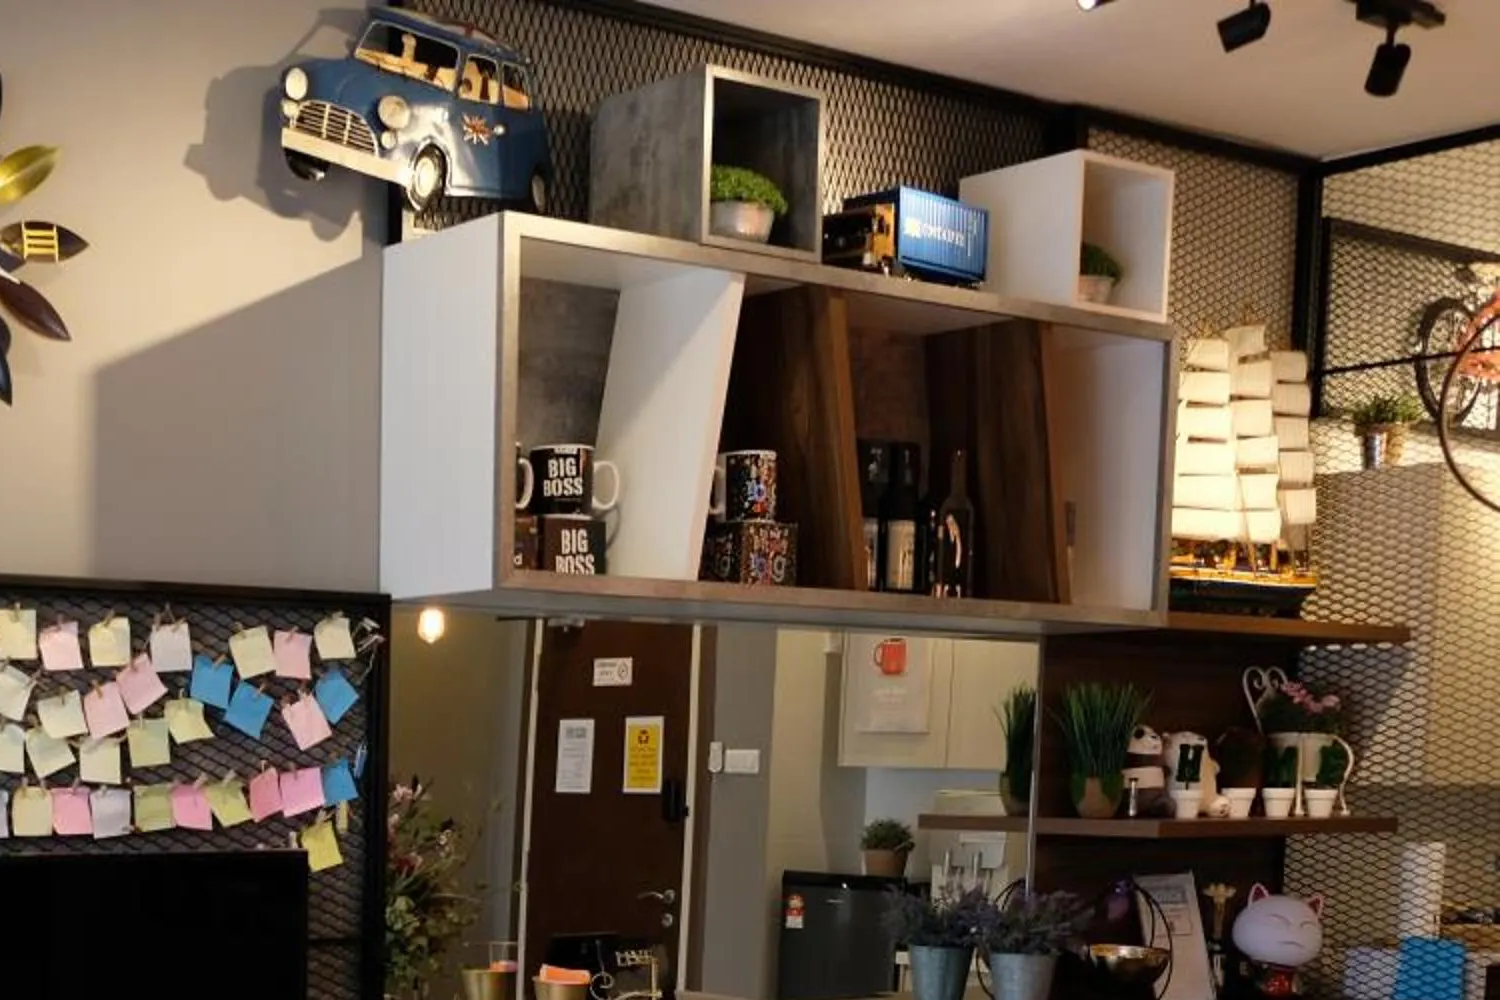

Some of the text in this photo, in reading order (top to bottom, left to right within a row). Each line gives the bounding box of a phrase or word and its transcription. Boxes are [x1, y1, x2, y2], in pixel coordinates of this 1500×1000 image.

[547, 457, 577, 479] BIG
[543, 477, 583, 498] BOSS
[561, 528, 589, 555] BIG
[555, 554, 595, 575] BOSS
